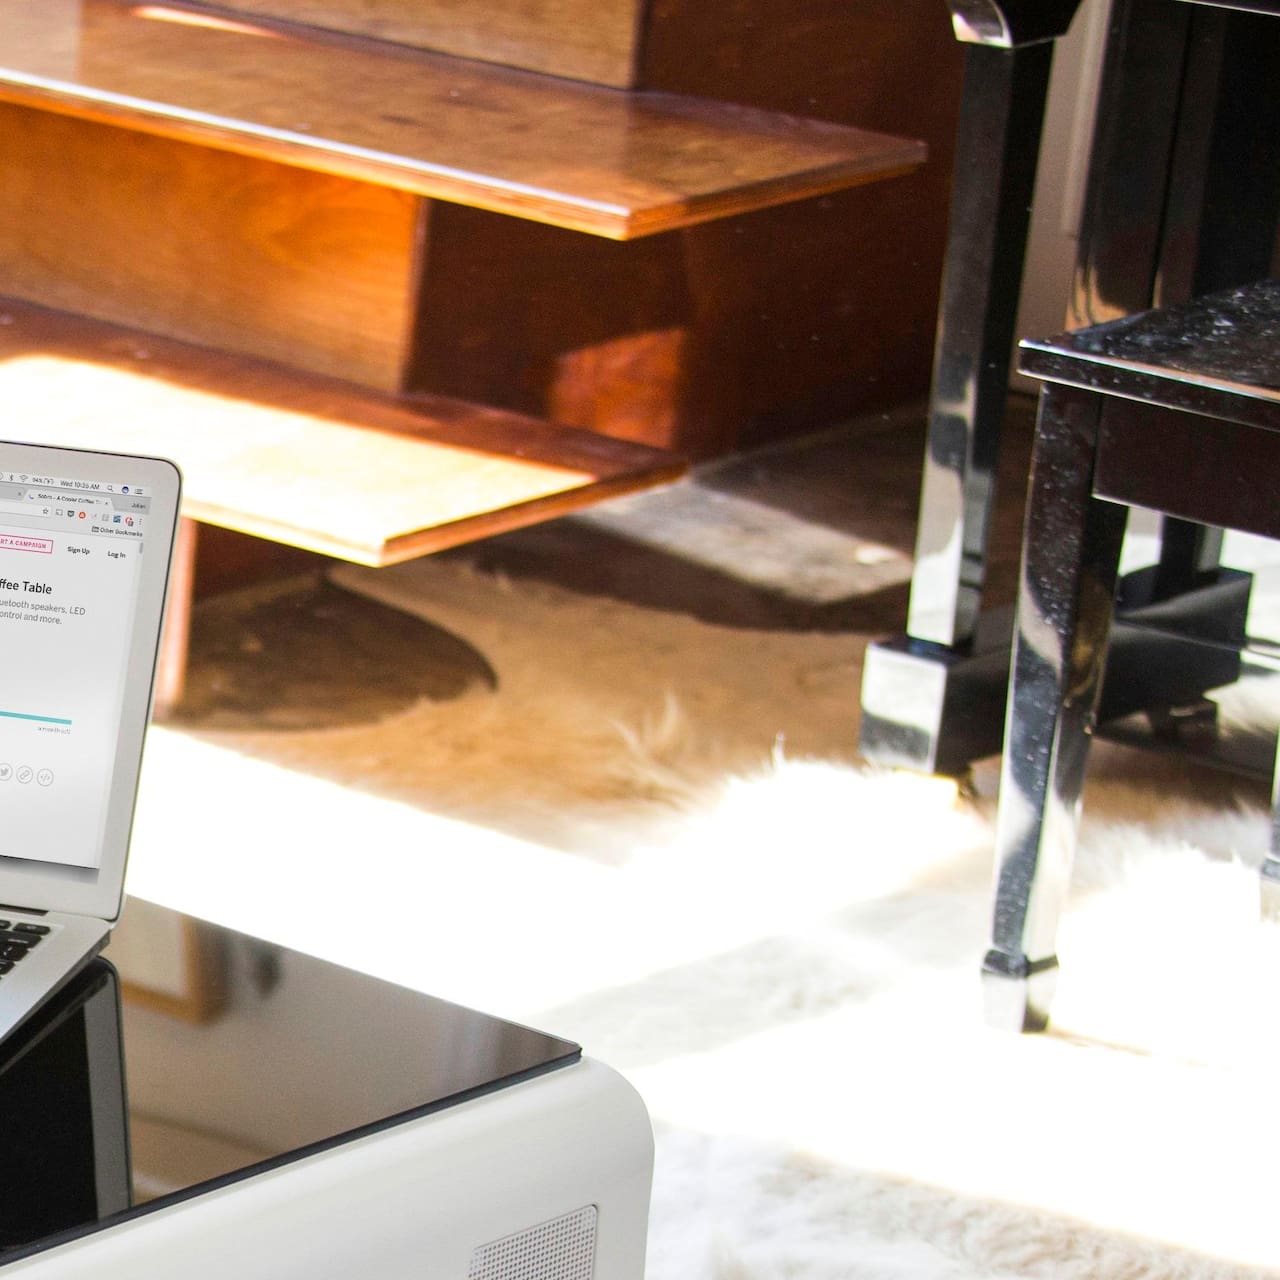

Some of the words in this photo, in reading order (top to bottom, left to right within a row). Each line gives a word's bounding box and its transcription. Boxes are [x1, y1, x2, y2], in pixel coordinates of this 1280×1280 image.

[15, 540, 47, 549] CAMPAIGN
[67, 546, 79, 554] Sign
[107, 551, 119, 559] Log
[23, 581, 53, 595] Table
[30, 601, 68, 615] speakers,
[69, 606, 86, 616] LED
[23, 612, 39, 622] and
[39, 615, 63, 625] more.
